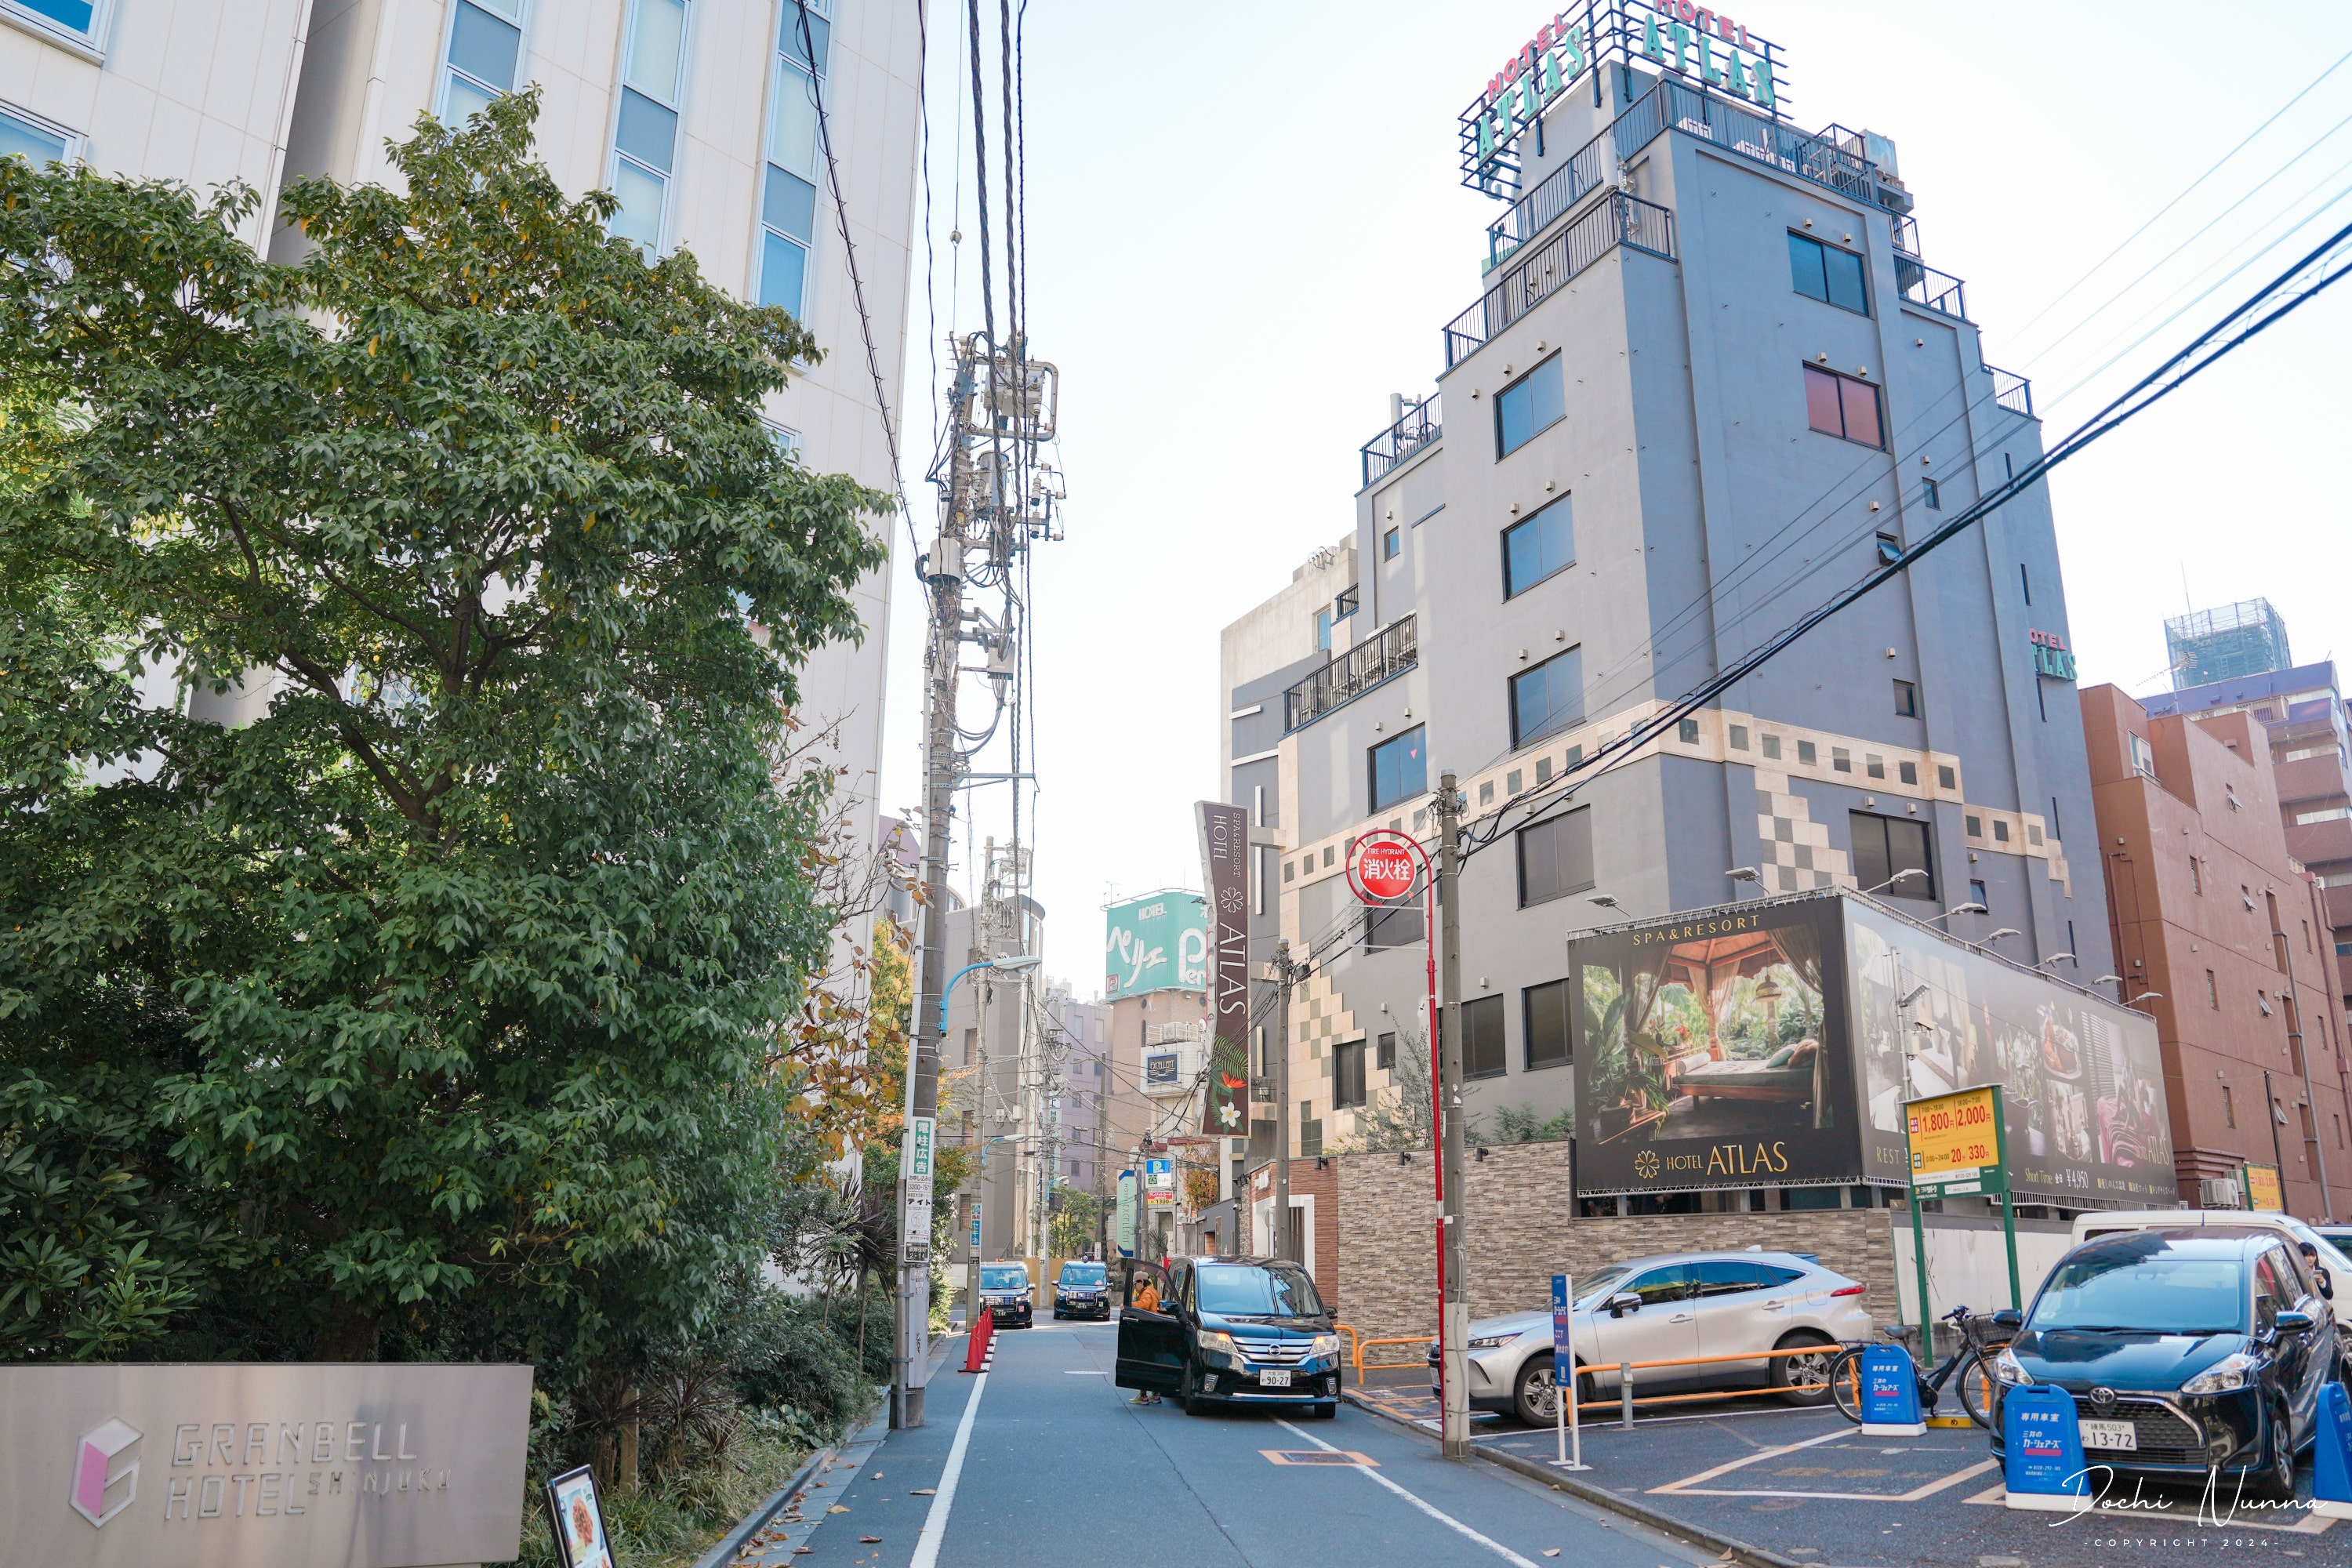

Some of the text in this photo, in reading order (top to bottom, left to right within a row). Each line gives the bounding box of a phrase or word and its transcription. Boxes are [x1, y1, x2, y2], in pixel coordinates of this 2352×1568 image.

[1487, 13, 1570, 102] HOTEL
[1641, 13, 1774, 107] ATLAS
[1479, 25, 1586, 165] ATLAS
[1214, 815, 1228, 861] HOTEL
[1363, 858, 1411, 880] 消火栓
[1138, 902, 1167, 921] HOTEL
[1632, 914, 1759, 946] SPA&RESORT
[1106, 926, 1167, 988] ペリエ
[1219, 921, 1247, 1015] ATLAS
[1150, 1060, 1174, 1070] EXCELLENT
[916, 1122, 929, 1173] 電柱広告
[1665, 1141, 1788, 1176] HOTEL ATLAS
[1876, 1146, 1900, 1164] REST
[2148, 1134, 2169, 1165] ATLAS
[1149, 1175, 1157, 1185] 空
[1153, 1161, 1162, 1173] P
[2025, 1167, 2038, 1183] Short
[2039, 1170, 2053, 1184] Time
[2020, 1413, 2060, 1422] 専用車室
[2107, 1423, 2122, 1432] 503
[172, 1421, 417, 1467] GRANBELL
[2023, 1438, 2062, 1449] カーシェアーズ
[2092, 1432, 2133, 1448] 13-72
[165, 1468, 451, 1519] HOTEL SHINJUKU
